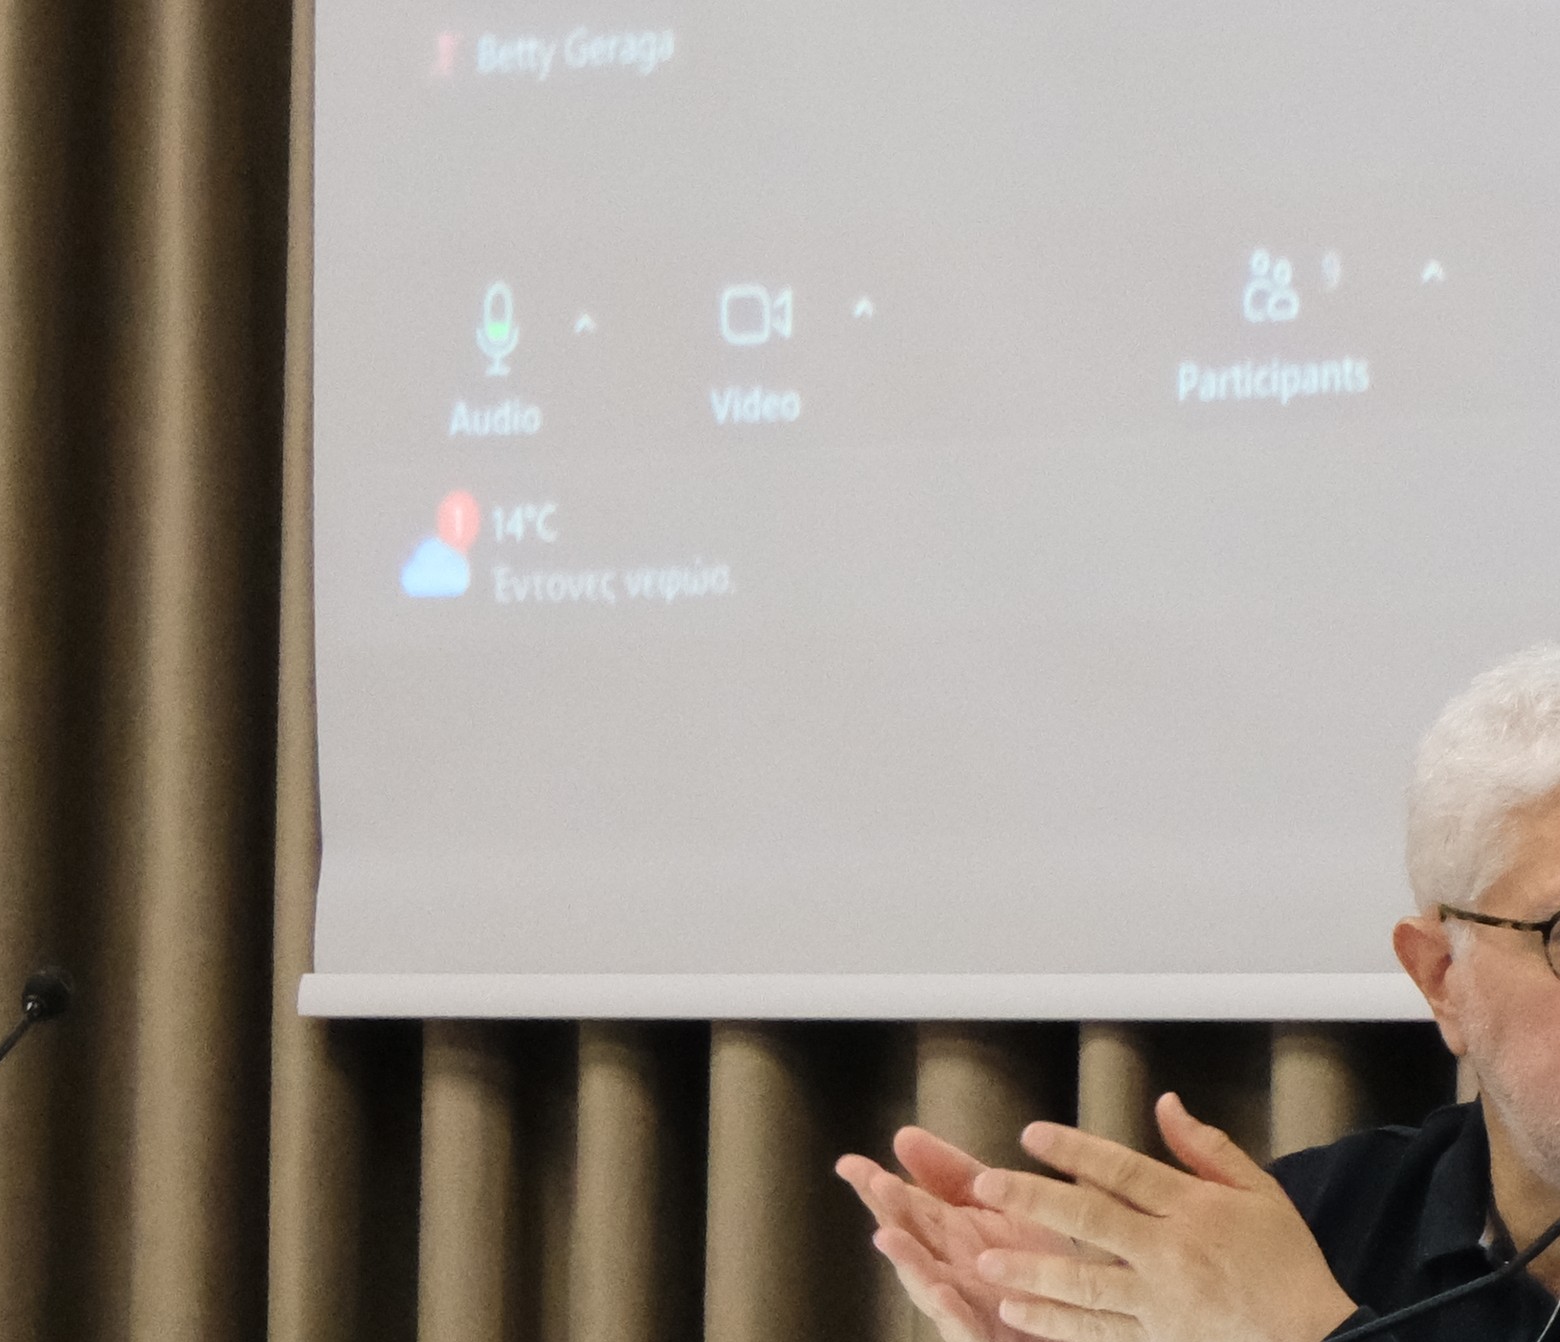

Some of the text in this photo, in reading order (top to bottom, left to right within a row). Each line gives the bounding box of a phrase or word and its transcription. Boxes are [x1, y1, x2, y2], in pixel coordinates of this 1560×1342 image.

[477, 33, 556, 81] Betty
[1177, 357, 1370, 405] Participants
[450, 398, 542, 437] Audio
[710, 386, 802, 424] Video
[492, 501, 558, 543] 14°C
